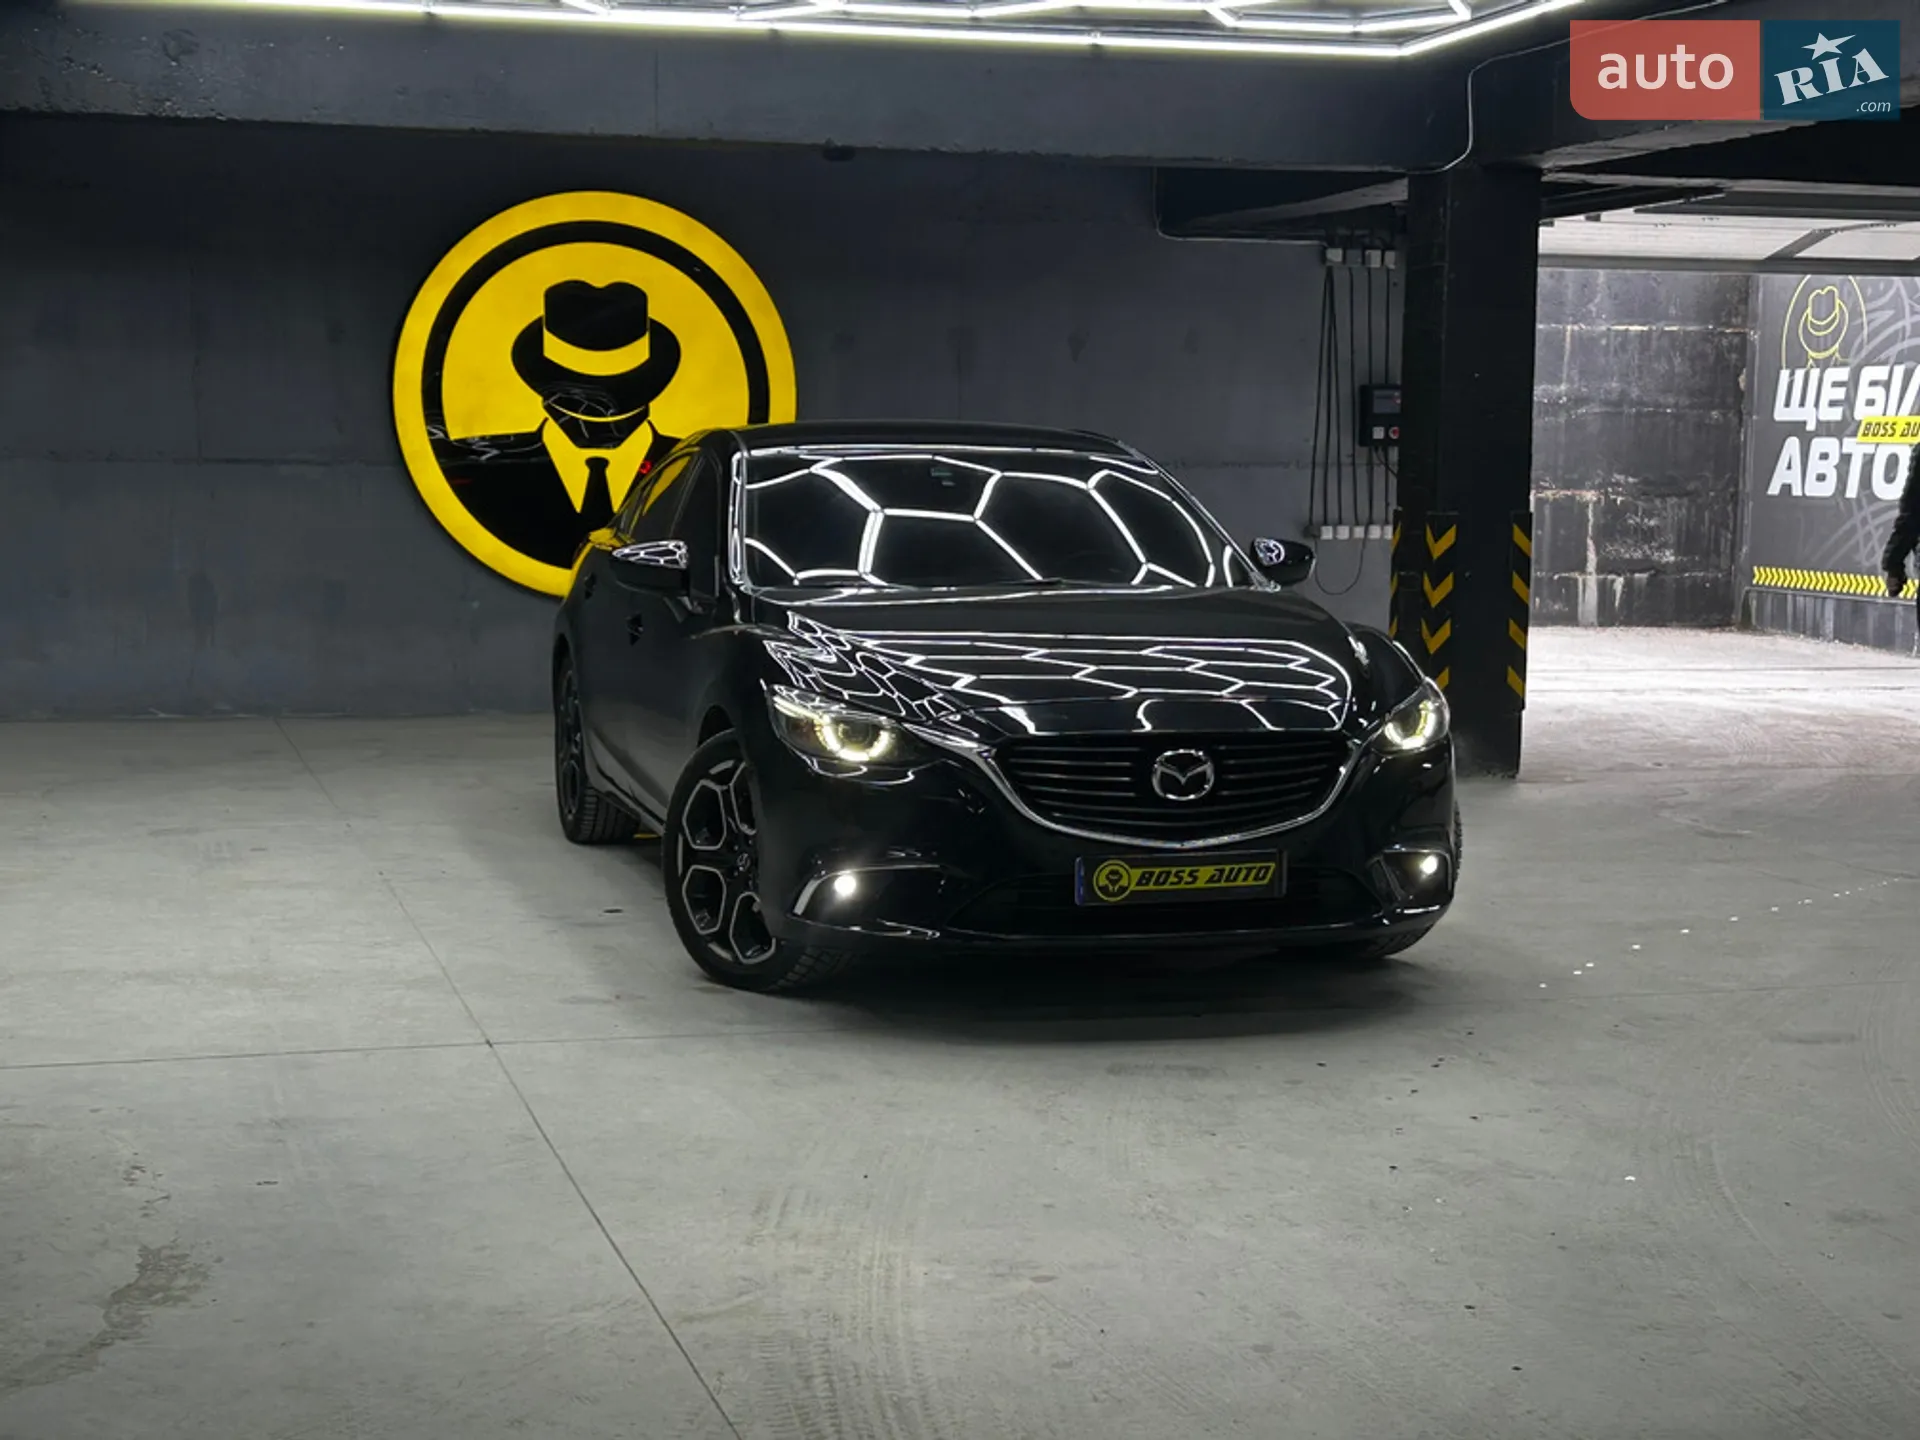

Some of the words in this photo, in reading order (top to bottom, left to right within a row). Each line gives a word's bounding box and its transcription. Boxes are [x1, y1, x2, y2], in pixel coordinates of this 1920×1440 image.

[1773, 366, 1850, 431] ЩЕ
[1861, 421, 1898, 437] BOSS
[1766, 436, 1911, 500] АВТО
[1135, 867, 1200, 887] BOSS
[1204, 865, 1272, 885] AUTO
